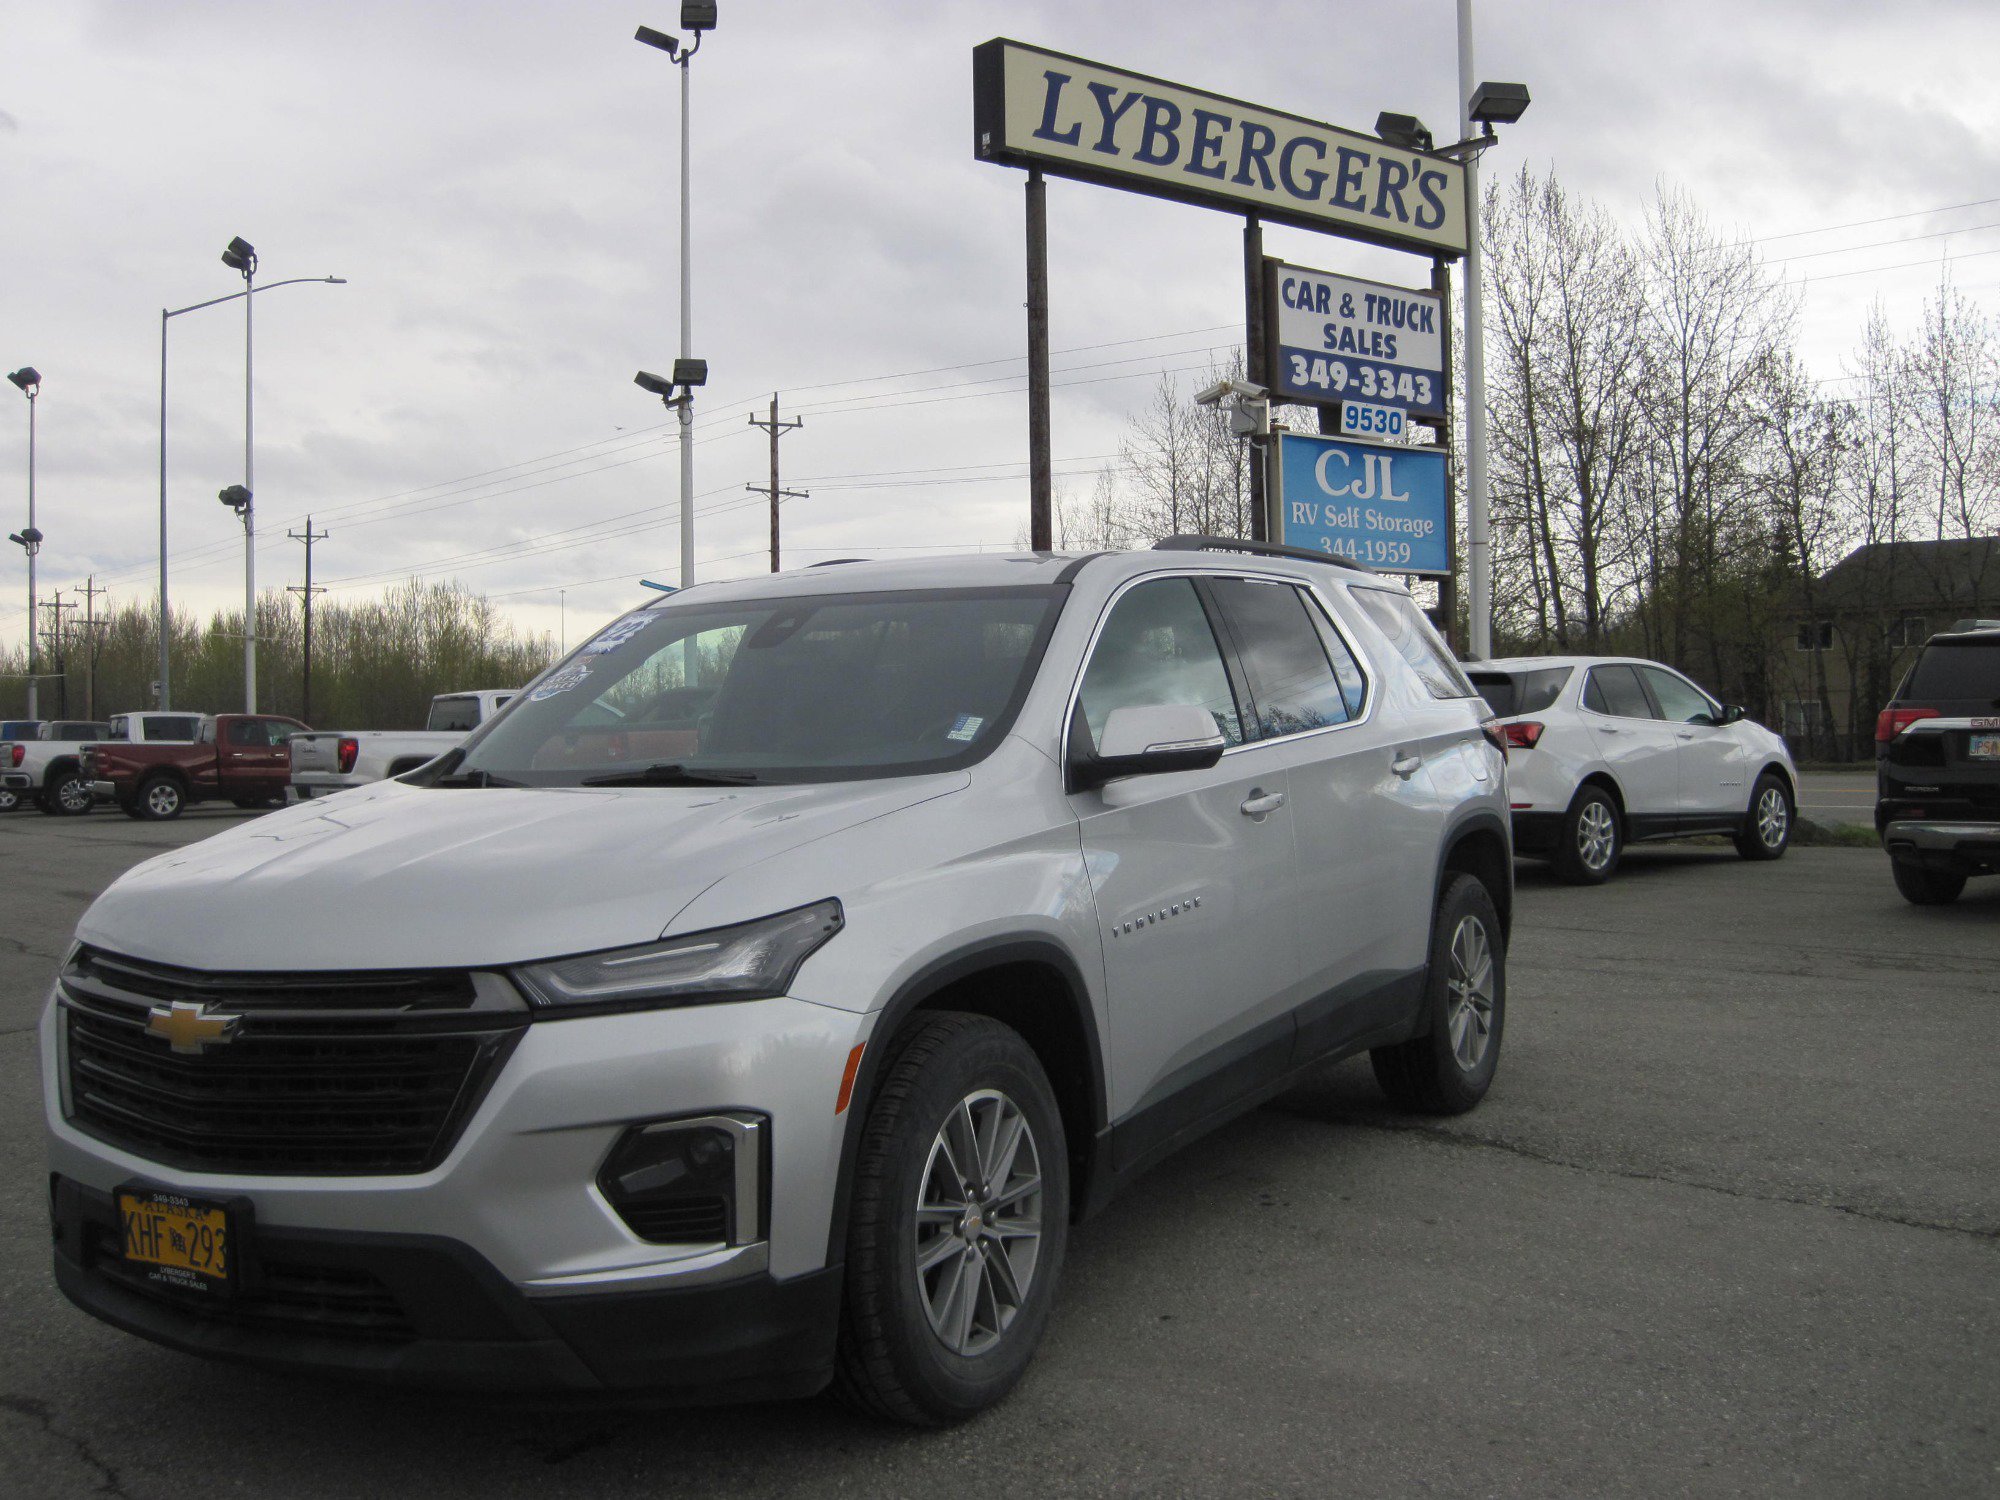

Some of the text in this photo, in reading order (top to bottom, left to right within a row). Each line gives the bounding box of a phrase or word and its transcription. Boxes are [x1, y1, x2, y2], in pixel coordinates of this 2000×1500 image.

[1033, 70, 1448, 230] LYBERGER'S
[1281, 278, 1435, 334] CAR & TRUCK
[1323, 323, 1398, 360] SALES
[1291, 354, 1432, 405] 349-3343
[1345, 405, 1402, 435] 9530
[1315, 449, 1410, 502] CJL
[1292, 501, 1434, 538] RV Self Storage
[1320, 536, 1411, 563] 344-1959
[1970, 718, 2000, 728] GM
[1112, 896, 1201, 938] TRAVERSE
[152, 1193, 189, 1207] 349-3343
[121, 1210, 227, 1273] KHF 293
